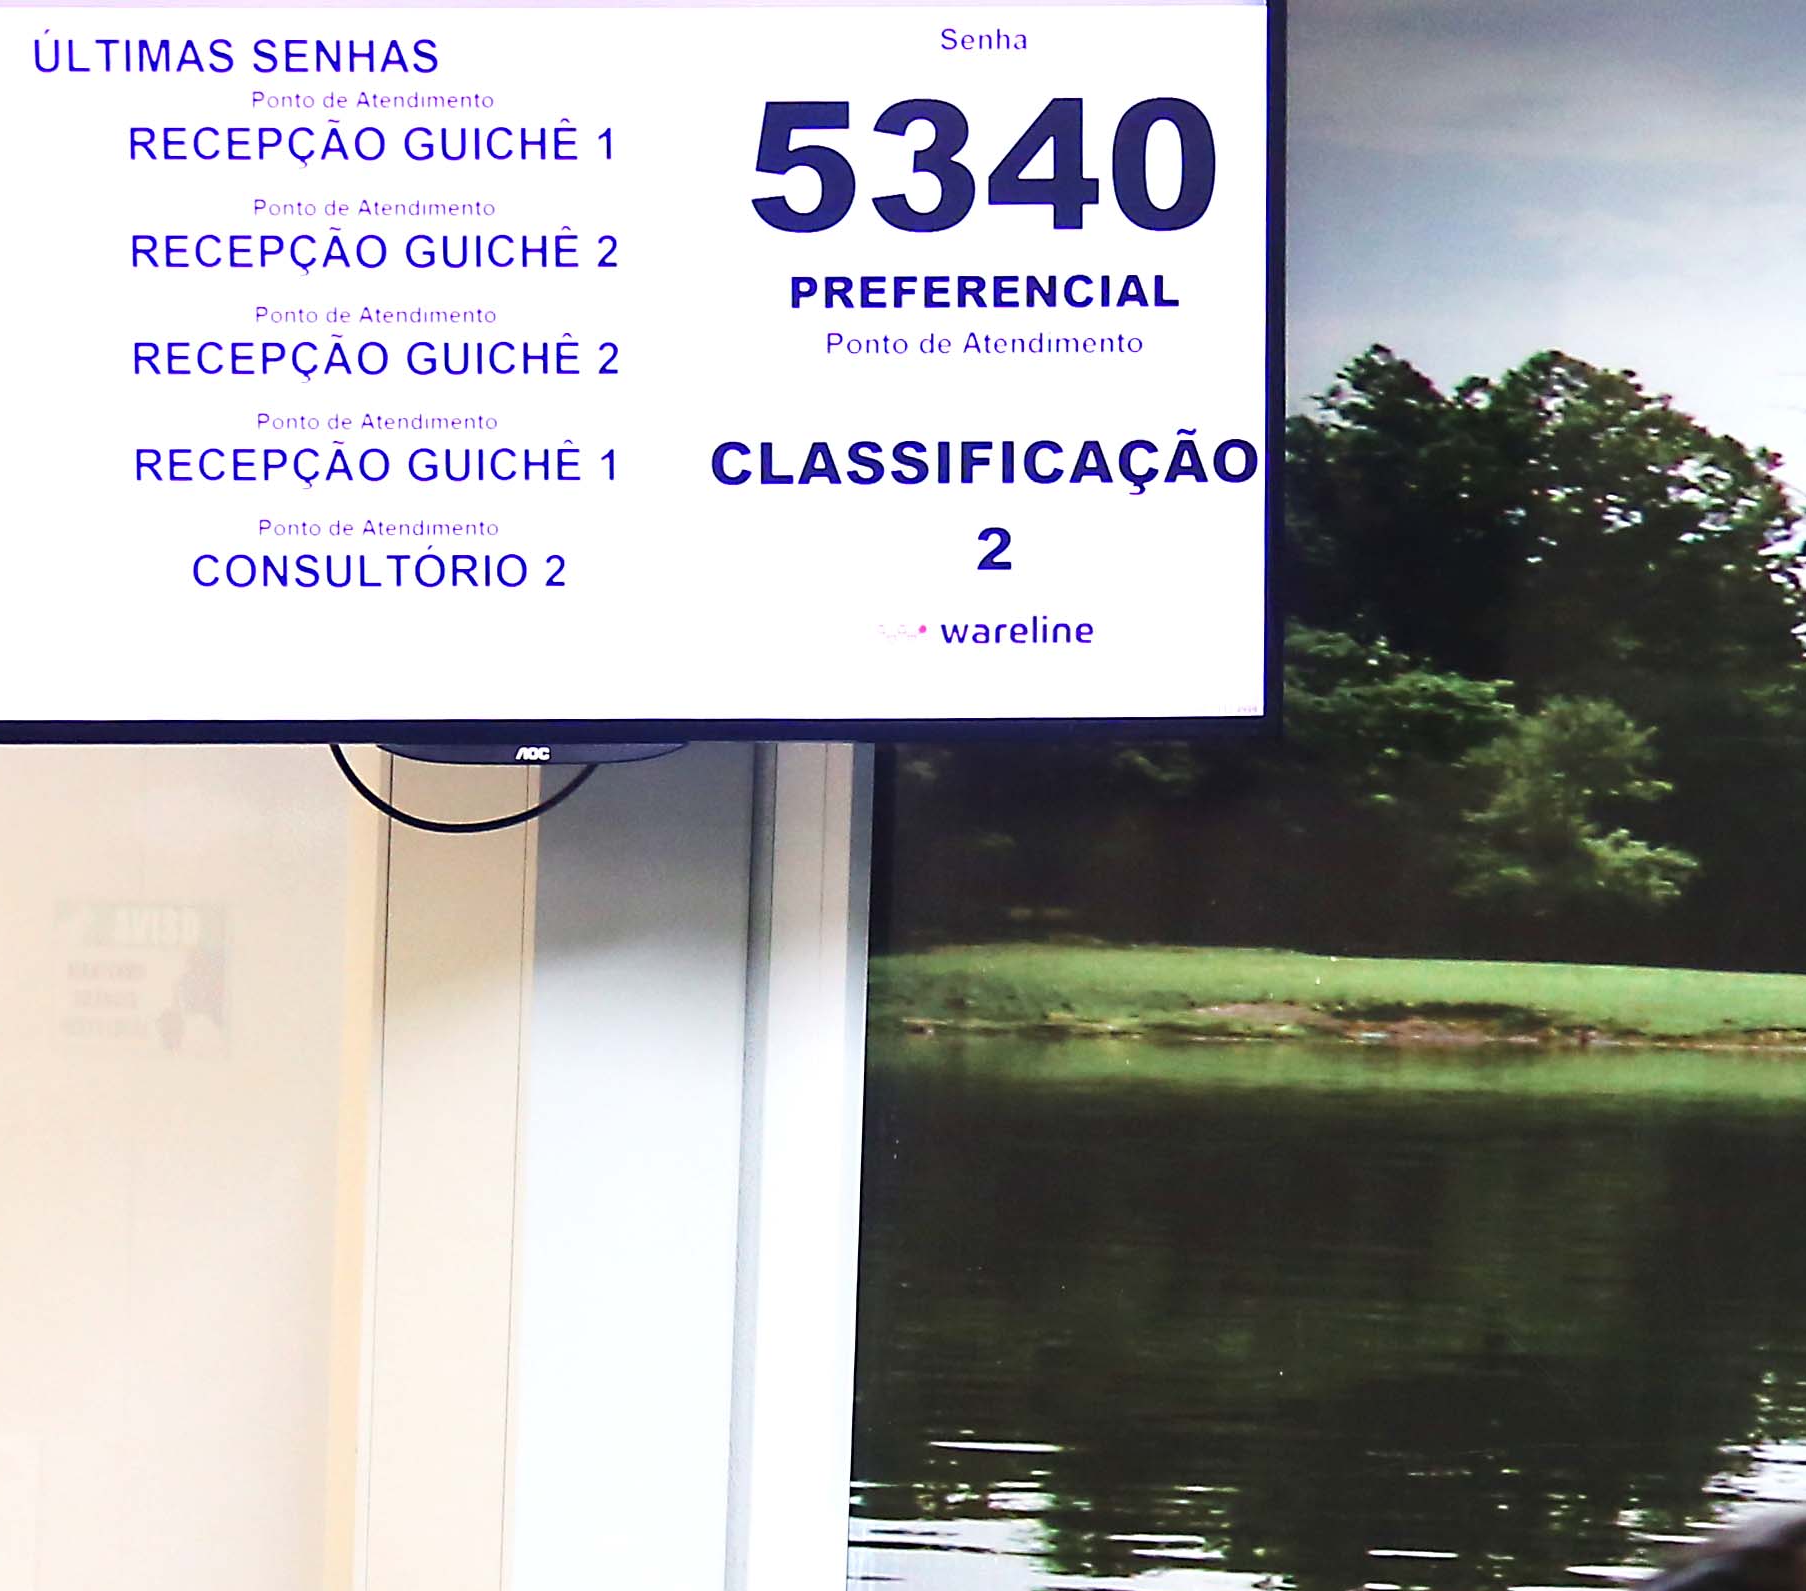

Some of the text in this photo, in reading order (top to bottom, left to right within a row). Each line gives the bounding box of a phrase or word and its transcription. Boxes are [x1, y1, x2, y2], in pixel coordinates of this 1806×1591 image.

[34, 29, 439, 75] ÚLTIMAS SENHAS
[941, 28, 1027, 50] Senha
[252, 91, 494, 108] Ponto de Atendimento
[130, 117, 612, 169] RECEPÇÃO GUICHÊ 1
[751, 97, 1216, 233] 5340
[254, 199, 495, 216] Ponto de Atendimento
[132, 226, 618, 276] RECEPÇÃO GUICHÊ 2
[791, 274, 1179, 309] PREFERENCIAL
[256, 306, 496, 323] Ponto de Atendimento
[134, 333, 618, 383] RECEPÇÃO GUICHÊ 2
[827, 332, 1143, 354] Ponto de Atendimento
[257, 413, 497, 430] Ponto de Atendimento
[136, 439, 614, 489] RECEPÇÃO GUICHÊ 1
[711, 428, 1258, 495] CLASSIFICAÇÃO
[259, 519, 498, 536] Ponto de Atendimento
[977, 527, 1012, 570] 2
[193, 545, 565, 588] CONSULTÓRIO 2
[940, 615, 1094, 644] wareline
[515, 746, 551, 761] AOC
